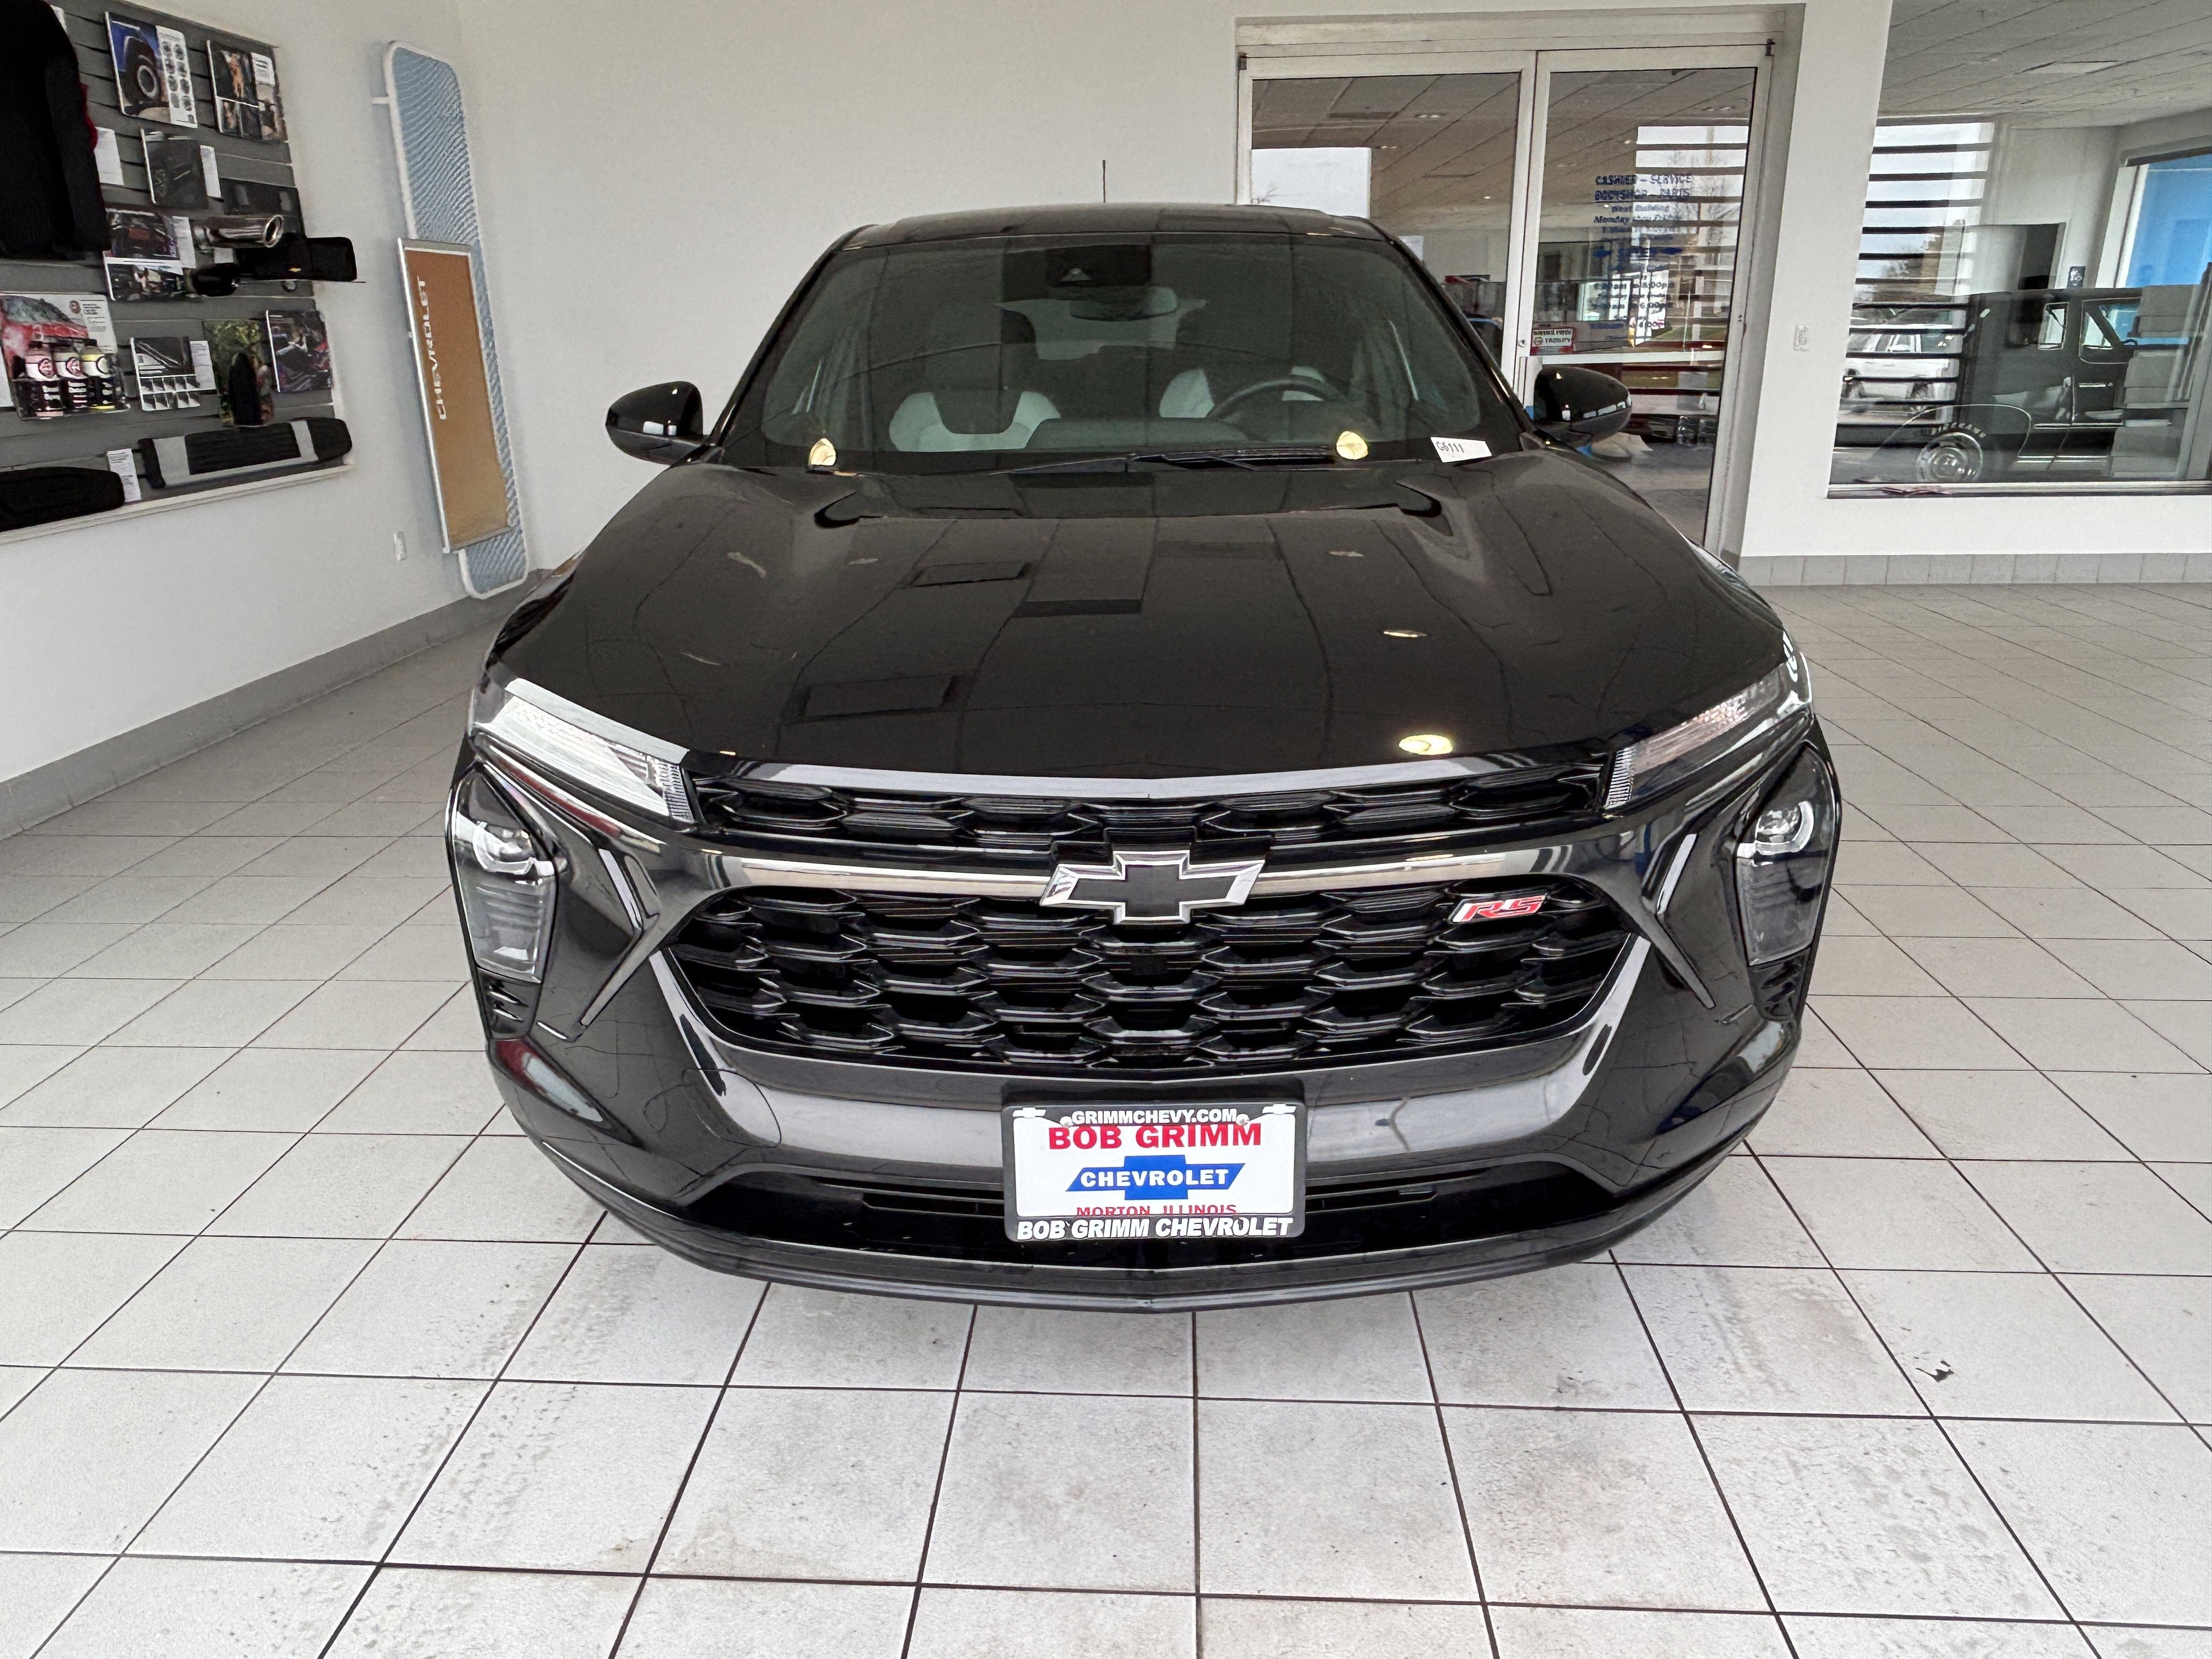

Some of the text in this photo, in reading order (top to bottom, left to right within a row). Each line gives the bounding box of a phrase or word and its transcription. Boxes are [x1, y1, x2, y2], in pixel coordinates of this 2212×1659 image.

[417, 275, 447, 420] CHEVROLET
[1452, 895, 1546, 923] RS
[1071, 1108, 1238, 1125] GRIMMCHEVY.COM
[1049, 1122, 1261, 1149] BOB GRIMM
[1080, 1169, 1229, 1187] CHEVROLET
[1017, 1216, 1294, 1240] BOB GRIMM CHEVROLET
